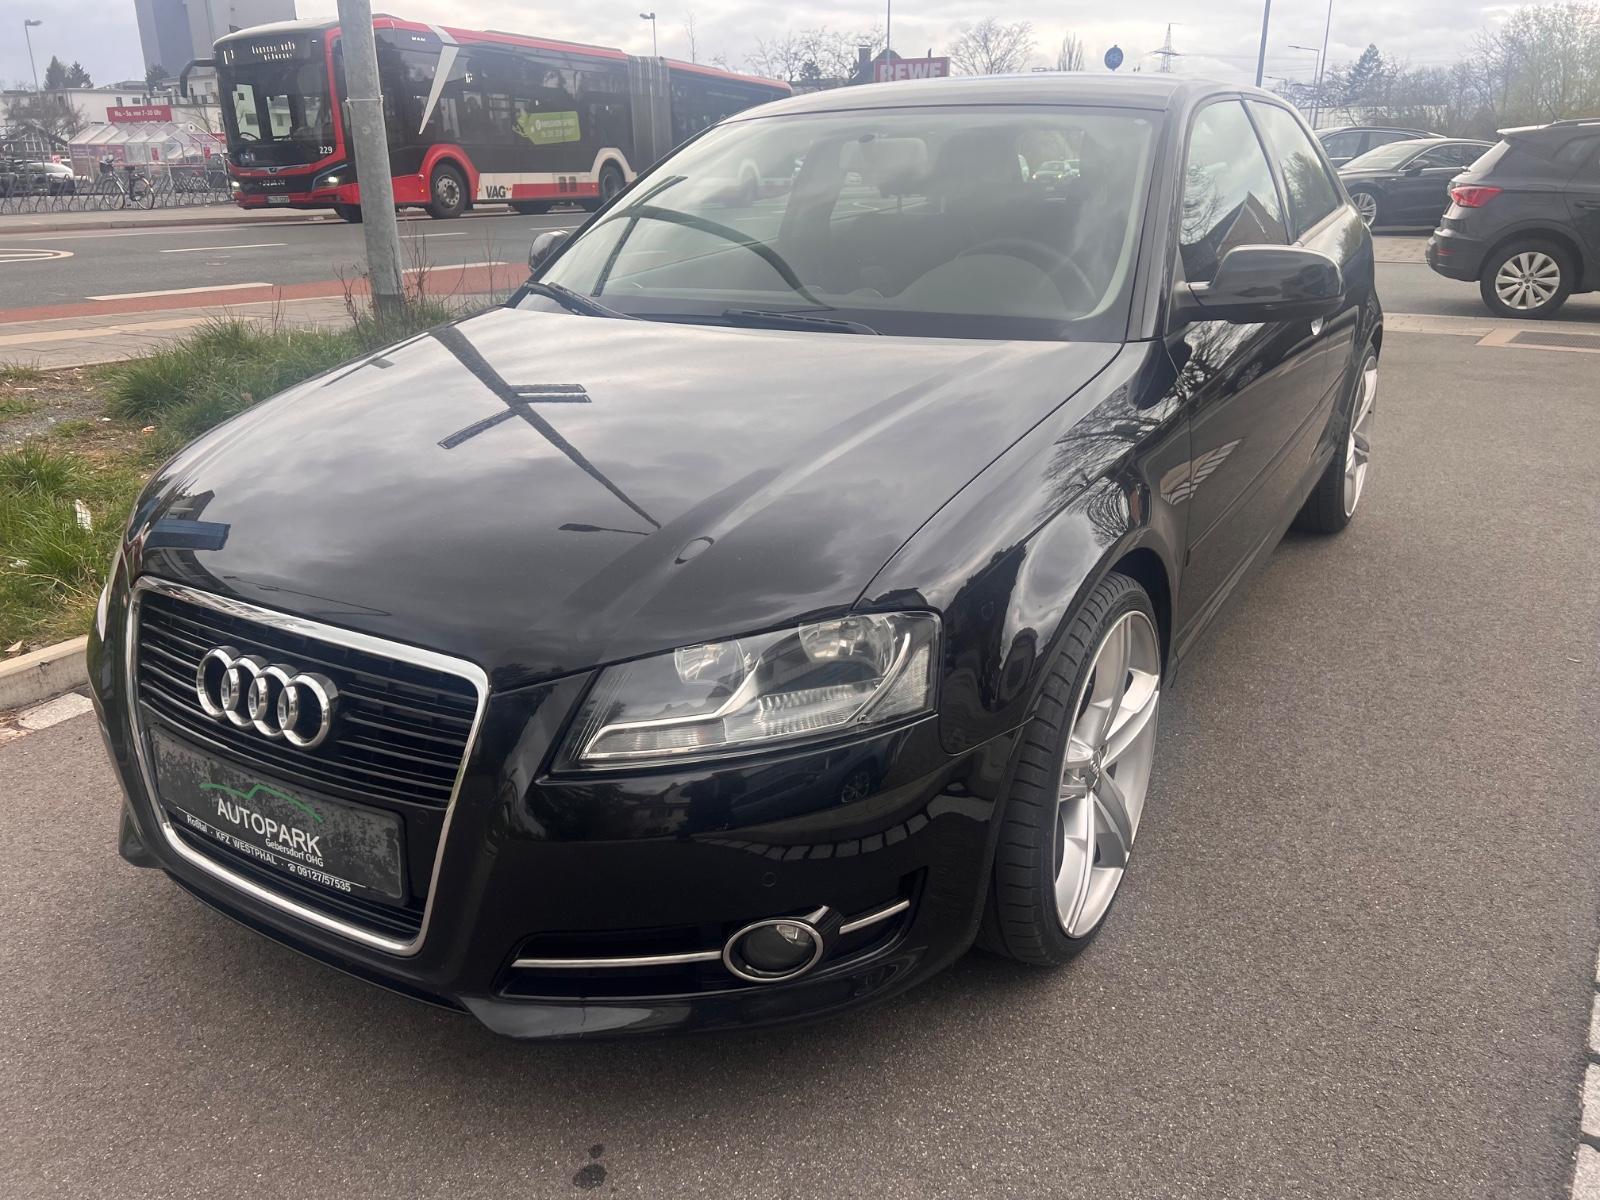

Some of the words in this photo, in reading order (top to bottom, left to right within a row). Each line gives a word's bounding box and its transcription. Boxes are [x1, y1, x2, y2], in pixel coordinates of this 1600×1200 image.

[880, 63, 942, 82] REWE
[319, 146, 333, 154] 229
[485, 185, 506, 199] VAG
[217, 797, 322, 857] AUTOPARK
[215, 830, 231, 845] KFZ
[232, 838, 278, 865] WESTPHAL
[297, 865, 351, 892] 09127/57535
[265, 838, 305, 860] Gebersdorf
[305, 853, 324, 867] OHG
